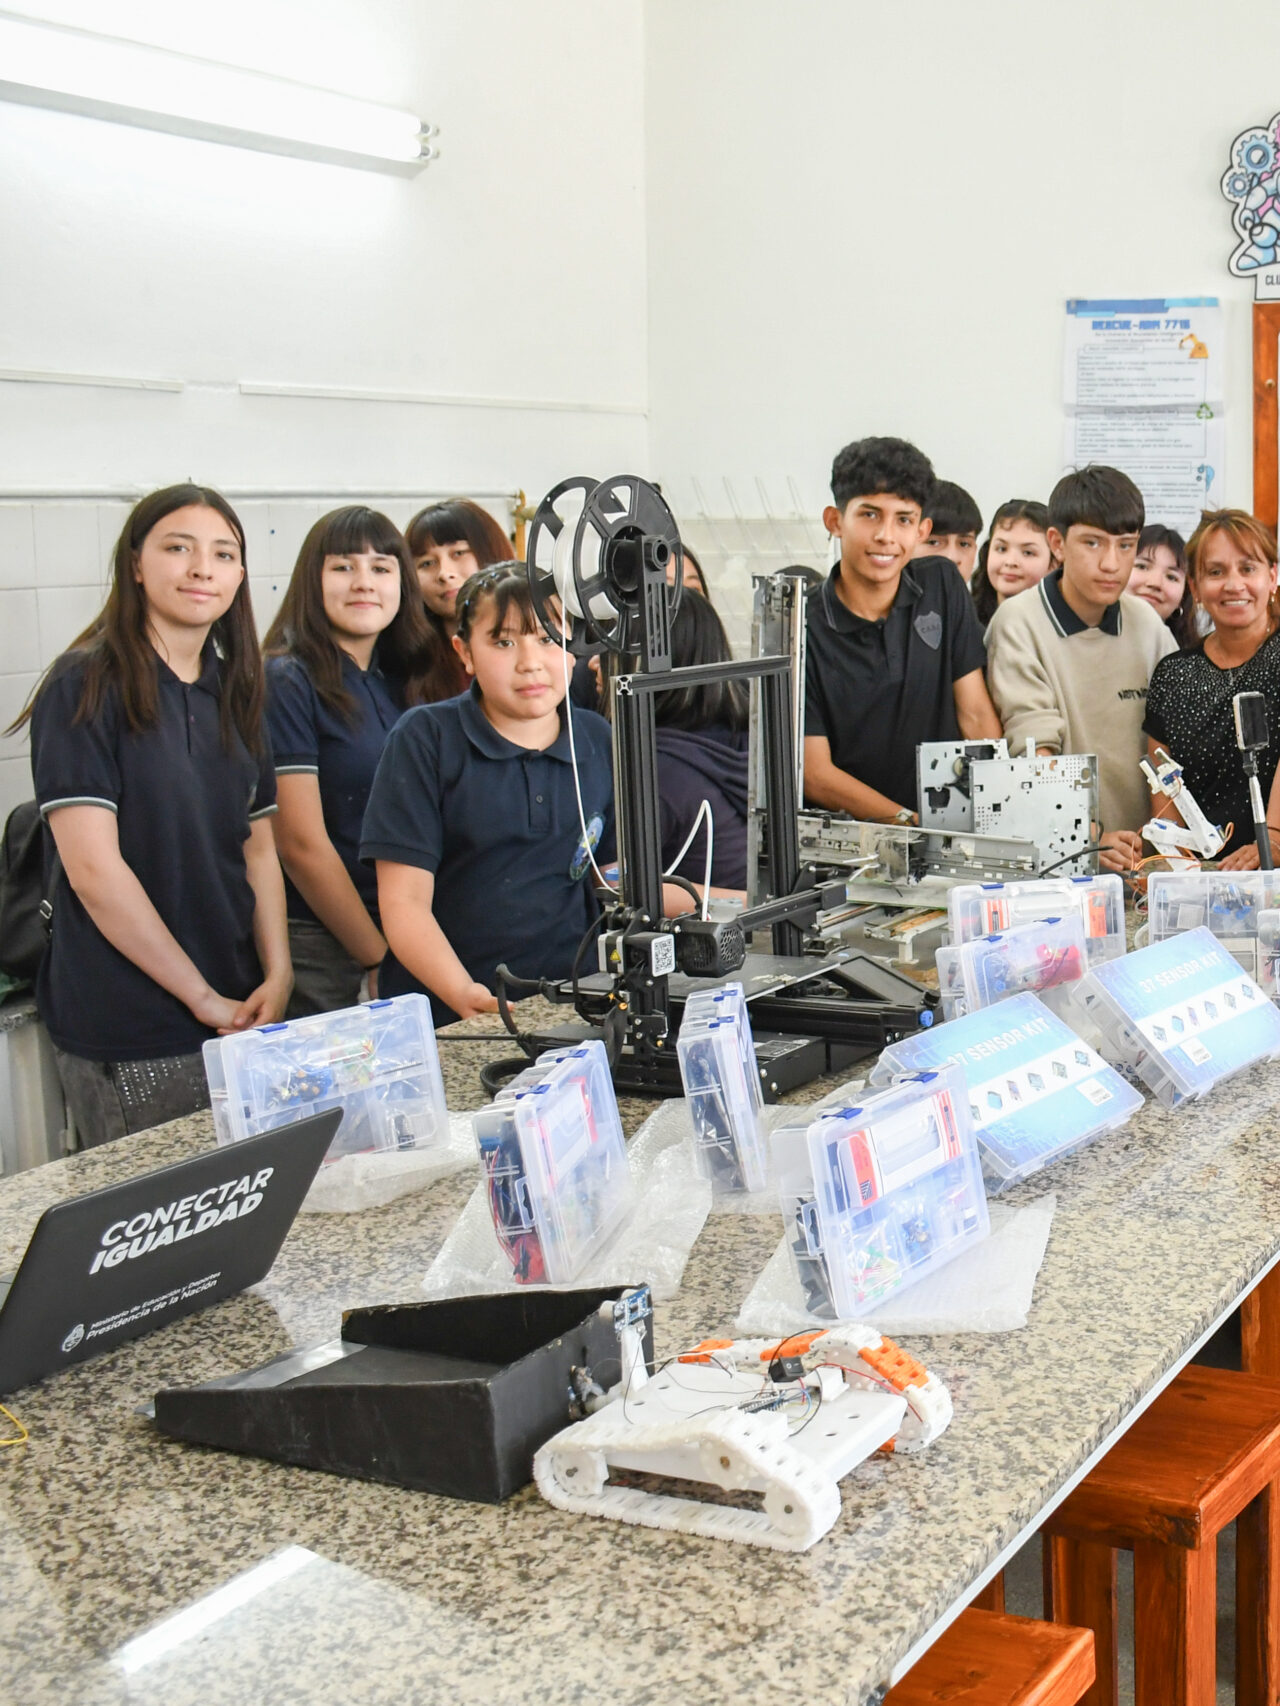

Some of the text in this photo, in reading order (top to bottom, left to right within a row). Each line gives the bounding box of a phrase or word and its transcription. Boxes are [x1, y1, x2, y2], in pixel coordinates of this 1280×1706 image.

[1139, 951, 1221, 992] 37 SENSOR KIT
[967, 1029, 1025, 1060] SENSOR
[1022, 1017, 1050, 1036] KIT
[89, 1192, 264, 1276] IGUALDAD
[102, 1167, 274, 1246] CONECTAR
[86, 1279, 218, 1340] Presidencia de la Nación
